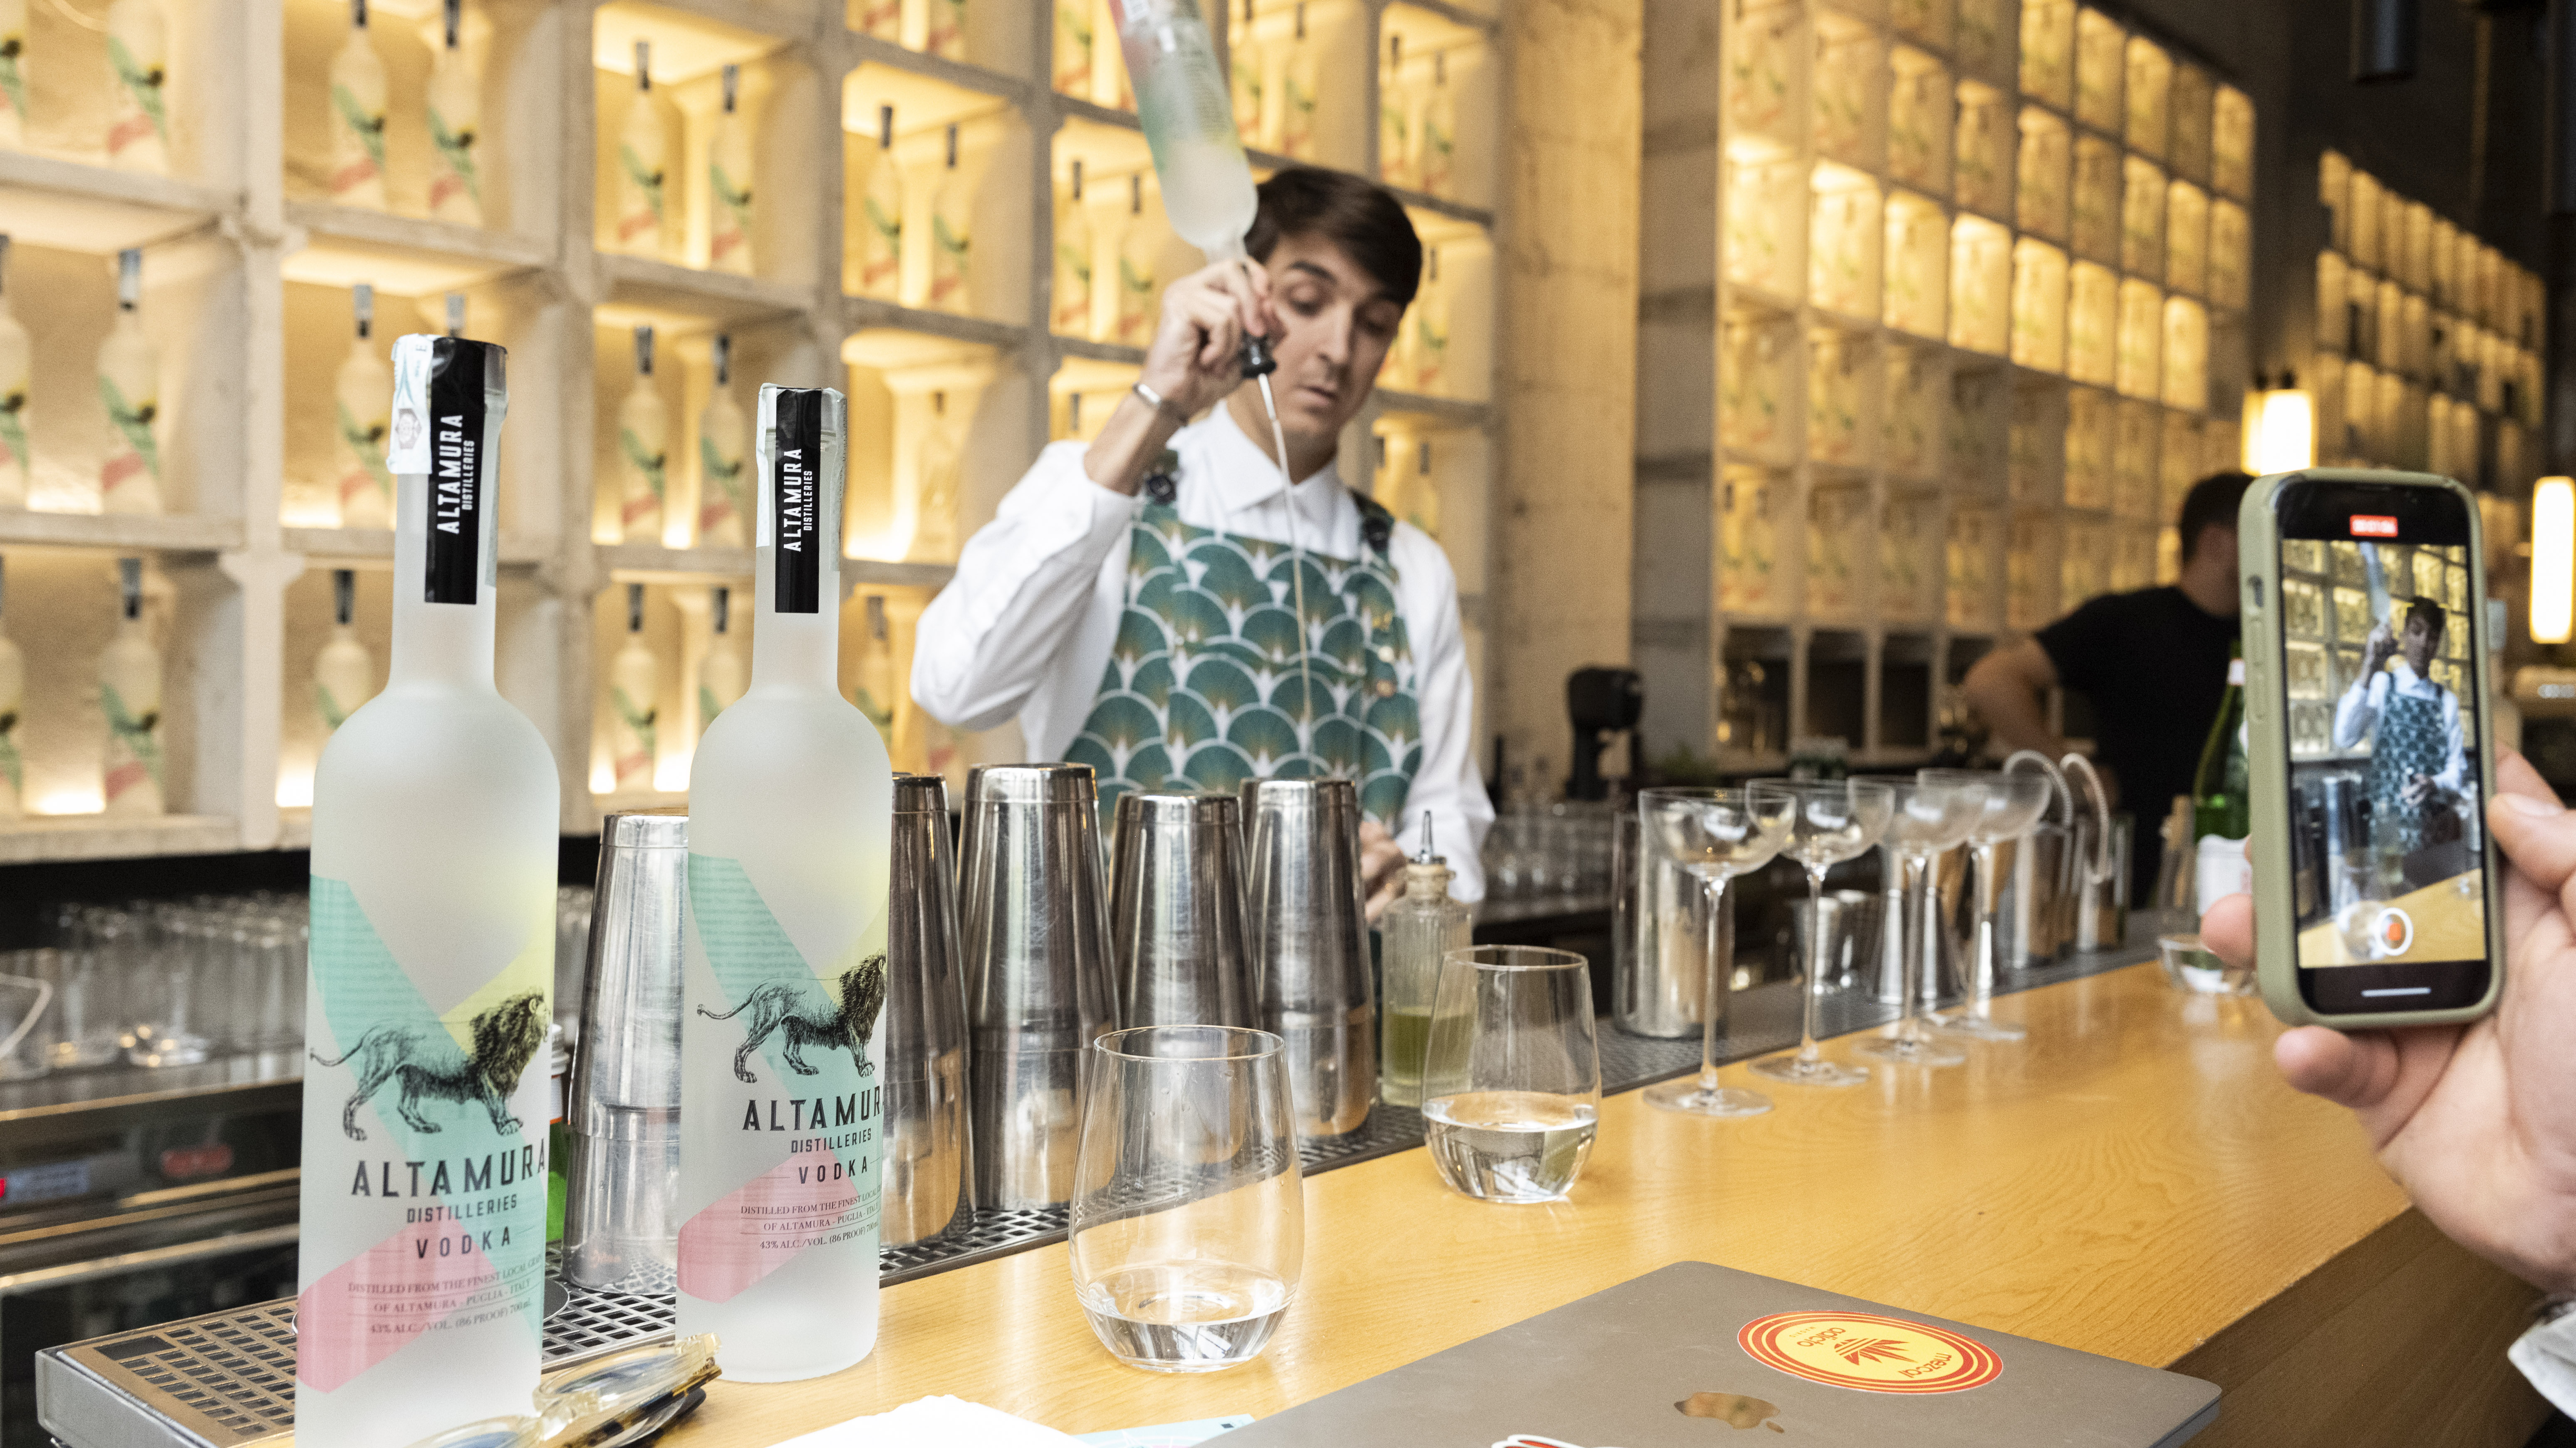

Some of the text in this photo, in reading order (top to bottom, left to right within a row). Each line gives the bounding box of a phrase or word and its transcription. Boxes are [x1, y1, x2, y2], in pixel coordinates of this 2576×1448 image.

[437, 415, 463, 534] ALTAMURA
[462, 440, 474, 510] DISTILLERIES
[784, 449, 801, 552] ALTAMURA
[804, 471, 812, 531] DISTILLERIES
[742, 1085, 883, 1131] ALTAMUR
[791, 1128, 872, 1153] DISTILLERIES
[351, 1138, 545, 1197] ALTAMURA
[798, 1156, 868, 1184] VODKA
[407, 1194, 517, 1223] DISTILLERIES
[741, 1188, 877, 1214] DISTILLED FROM THE FINEST LOCAL
[780, 1219, 830, 1230] ALTAMURA
[837, 1211, 862, 1224] PUGLIA
[417, 1227, 510, 1259] VODKA
[780, 1237, 827, 1248] ALC./VOL.
[830, 1235, 841, 1244] (86
[843, 1227, 866, 1240] PROOF)
[349, 1283, 405, 1294] DISTILLED
[408, 1282, 439, 1292] FROM
[442, 1278, 465, 1289] THE
[467, 1271, 499, 1287] FINEST
[374, 1303, 391, 1312] OF
[395, 1299, 456, 1312] ALTAMURA
[466, 1290, 503, 1305] PUGLIA
[1797, 1327, 1846, 1346] adicto
[1897, 1353, 1952, 1378] mezcal
